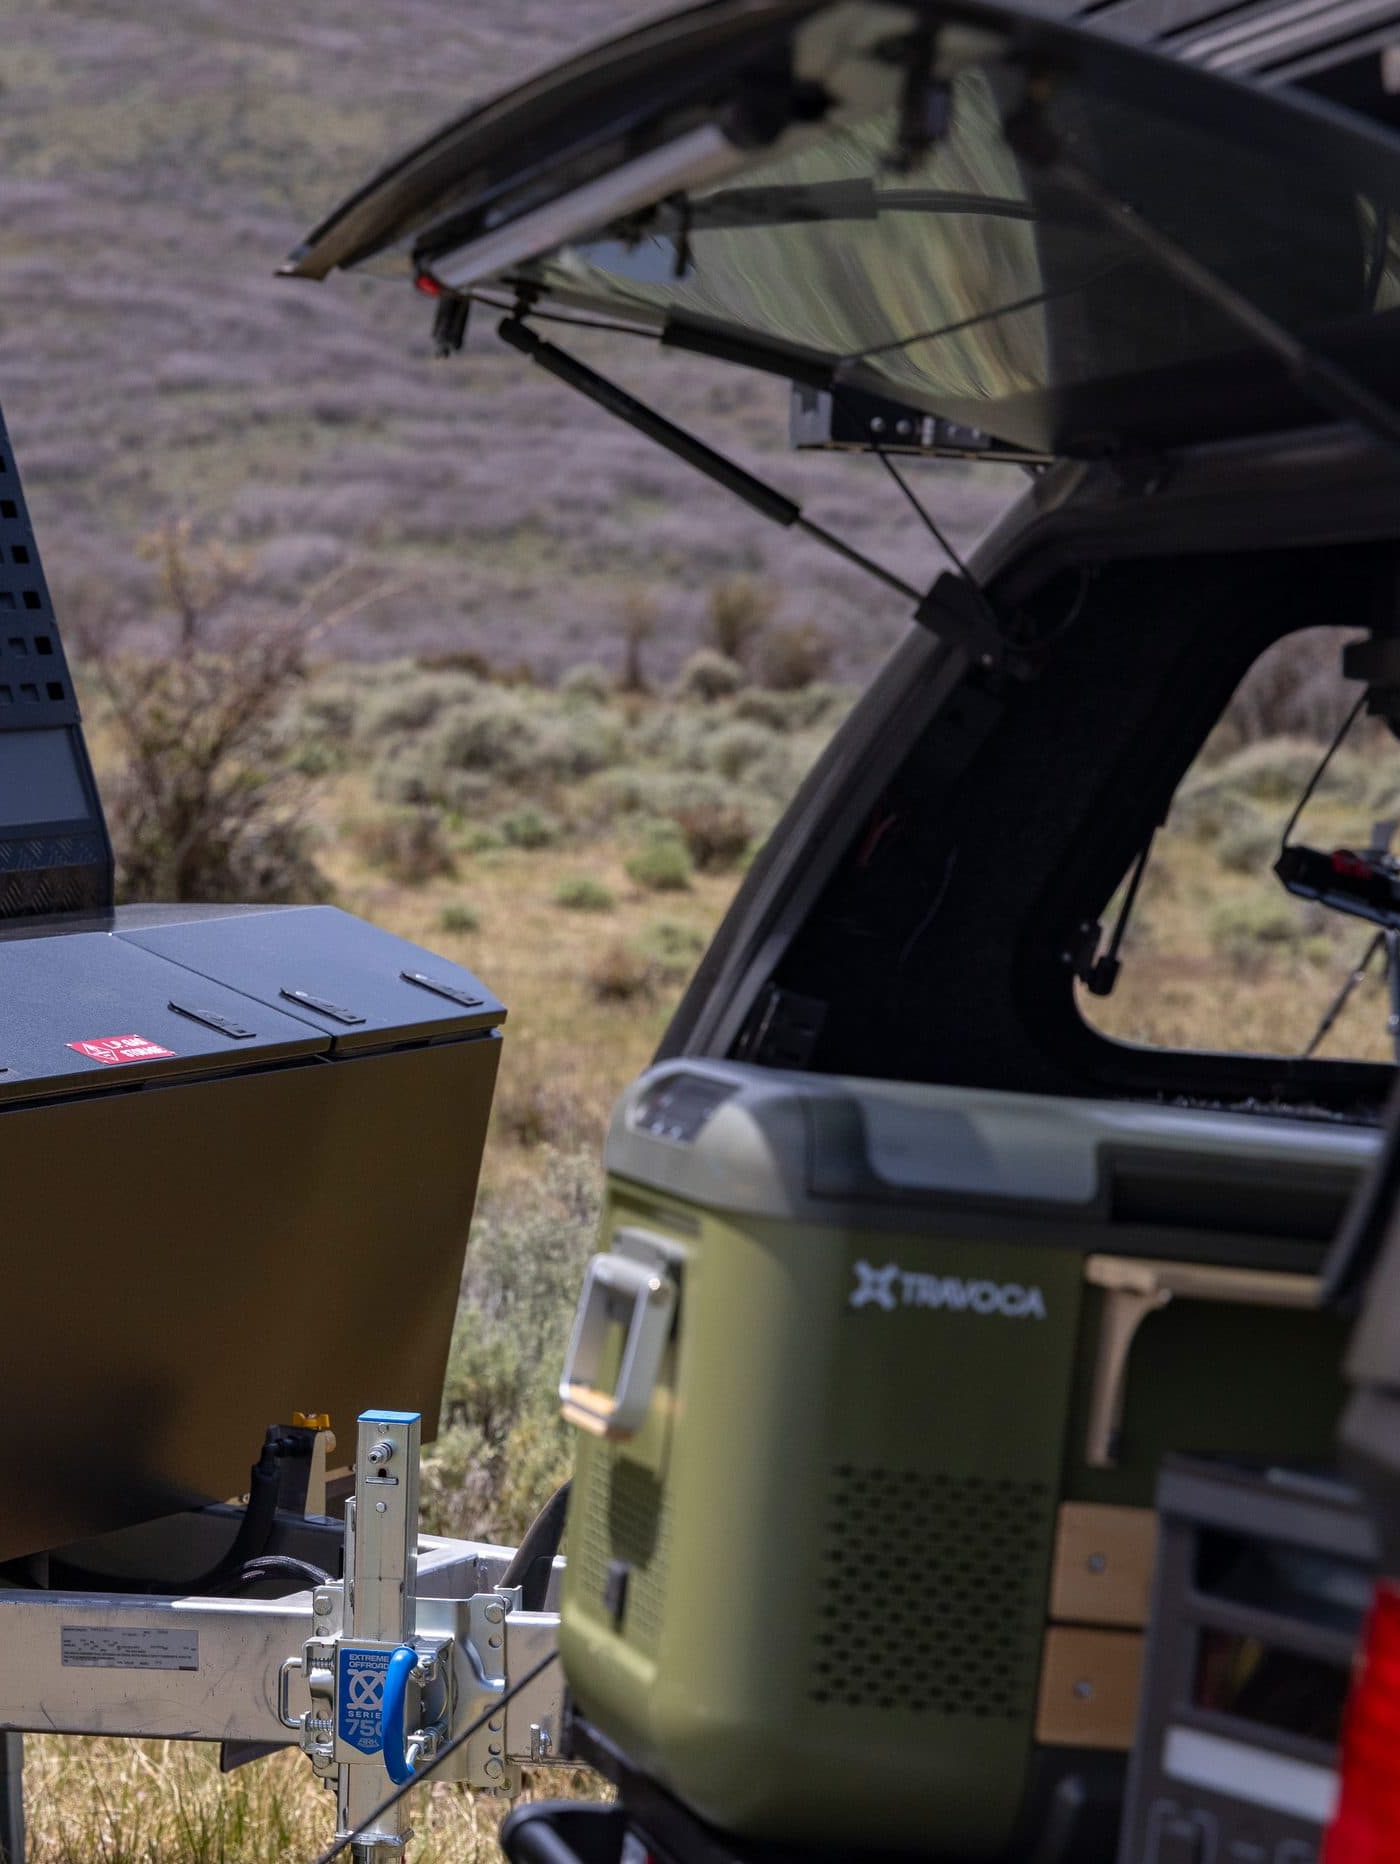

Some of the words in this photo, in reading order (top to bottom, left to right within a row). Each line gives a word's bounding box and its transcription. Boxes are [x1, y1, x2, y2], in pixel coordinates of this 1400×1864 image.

[901, 1271, 1046, 1319] TRAVOCA
[349, 1653, 389, 1663] EXTREME
[349, 1661, 389, 1669] OFFROAD
[348, 1710, 382, 1719] SERIE
